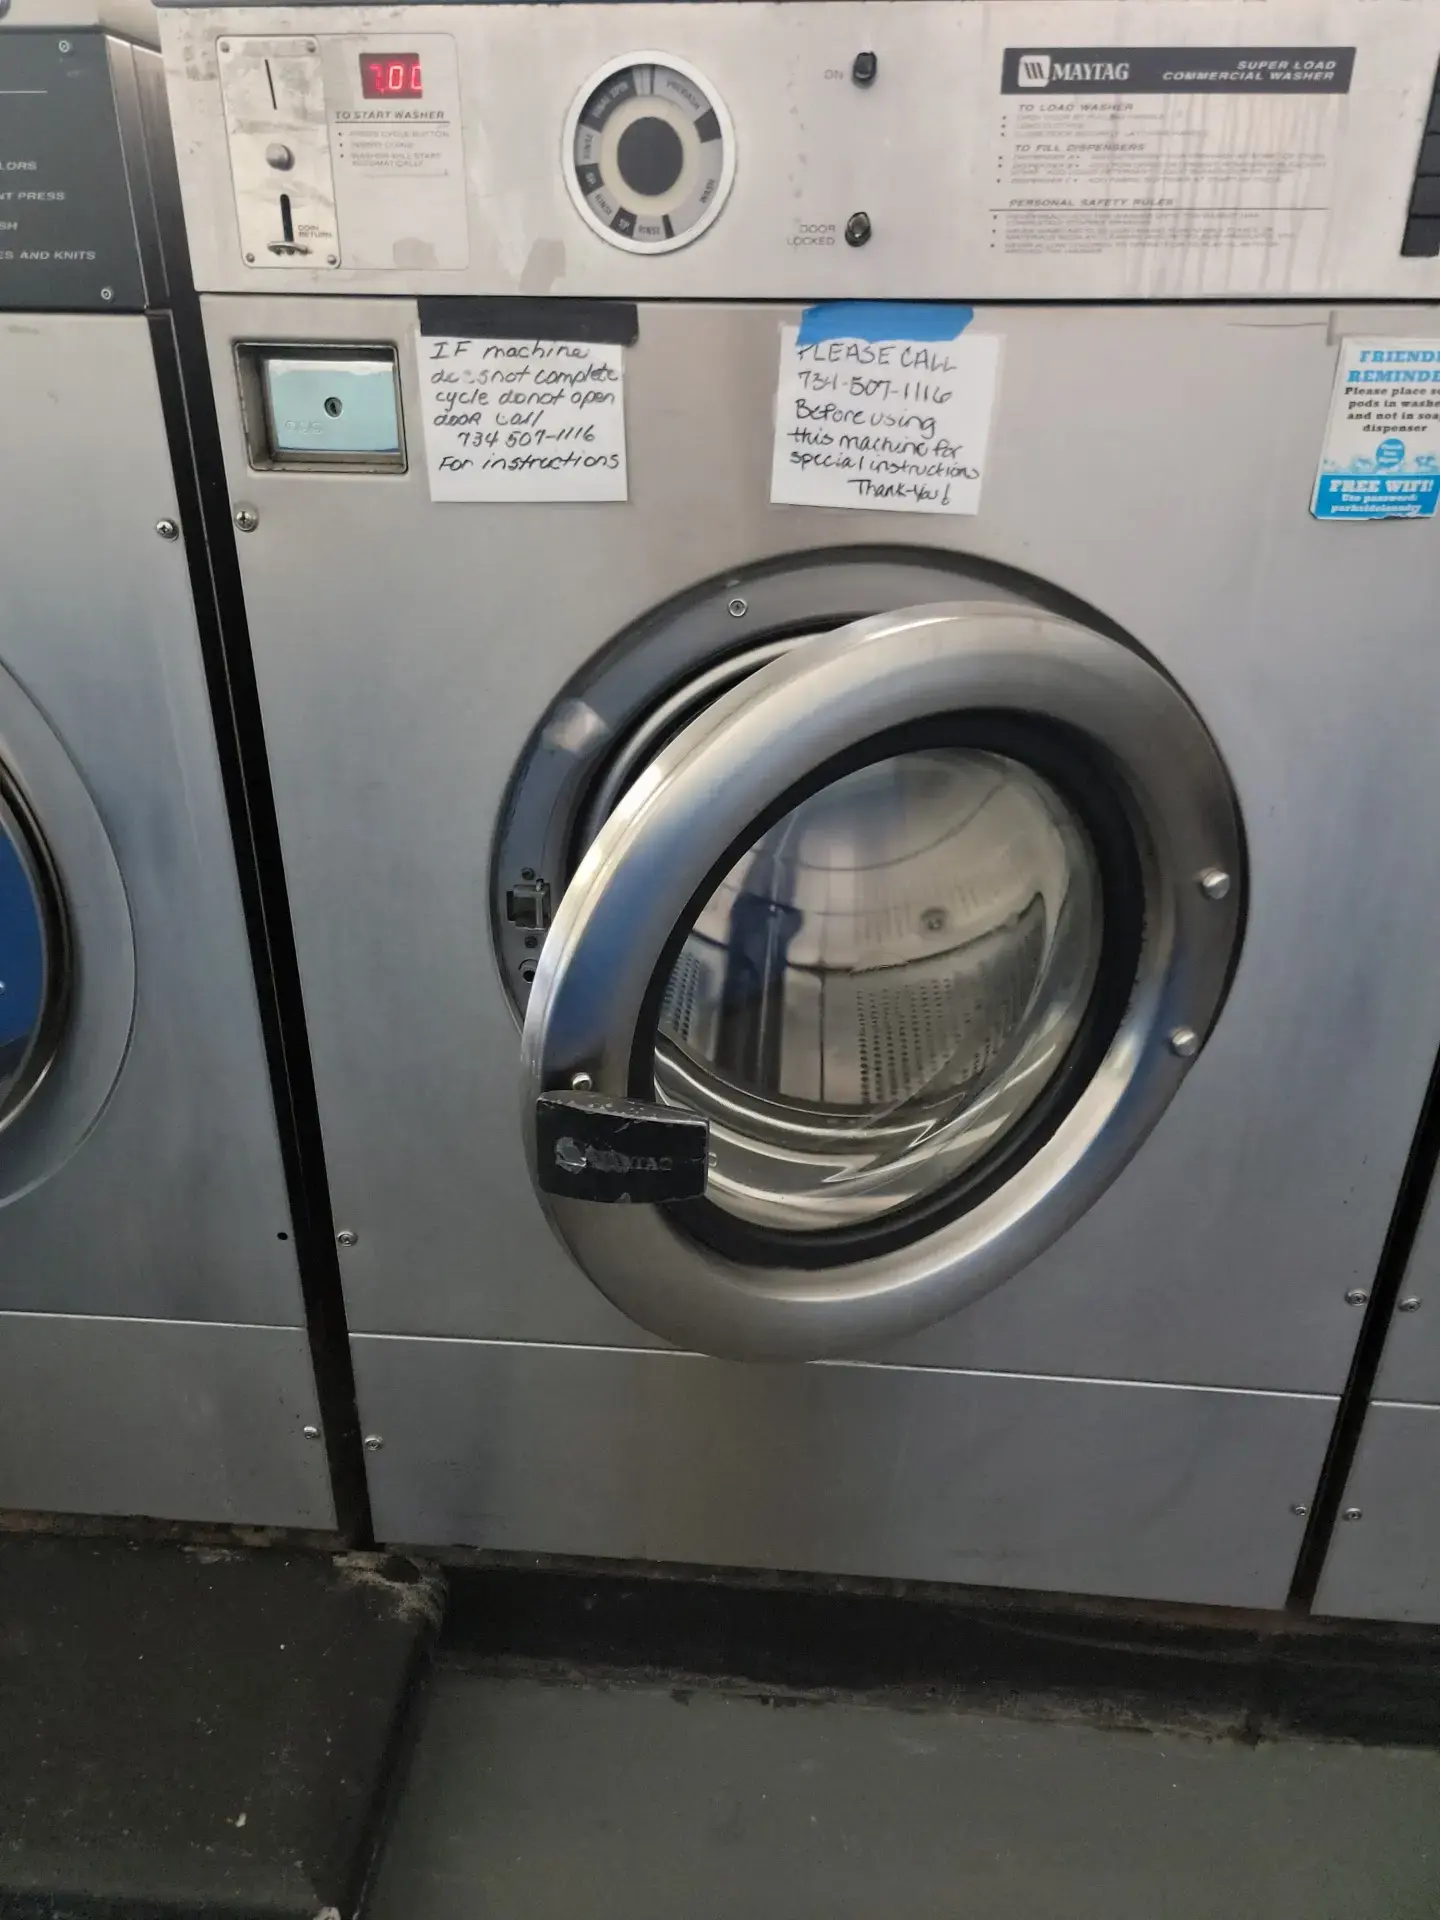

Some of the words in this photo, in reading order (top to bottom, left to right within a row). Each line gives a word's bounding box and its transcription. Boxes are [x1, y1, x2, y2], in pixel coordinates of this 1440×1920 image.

[1236, 60, 1290, 70] SUPER
[1293, 60, 1337, 70] LOAD
[824, 69, 844, 80] ON
[1052, 62, 1130, 80] MAYTAG
[1162, 71, 1264, 81] COMMERCIAL
[1269, 71, 1335, 81] WASHER
[1018, 104, 1035, 112] TO
[1040, 104, 1075, 112] LOAD
[1080, 103, 1134, 112] WASHER
[335, 110, 351, 119] TO
[353, 110, 391, 119] START
[394, 110, 445, 119] WASHER
[1015, 144, 1031, 152] TO
[1036, 144, 1061, 152] FILL
[1066, 143, 1146, 152] DISPENSERS
[18, 191, 65, 200] PRESS
[1009, 198, 1074, 207] PERSONAL
[1080, 198, 1128, 207] SAFETY
[1132, 198, 1173, 206] RULES
[800, 224, 836, 234] DOOR
[298, 231, 333, 239] RETURN
[787, 236, 836, 247] LOCKED
[20, 251, 50, 260] AND
[54, 250, 96, 260] KNITS
[483, 338, 590, 360] machine
[900, 346, 957, 372] CALL
[534, 362, 619, 388] complete
[799, 371, 953, 405] 734-507-1116
[1344, 387, 1388, 396] Please
[1391, 387, 1428, 398] place
[436, 388, 489, 411] cycle
[570, 390, 616, 410] open
[1348, 399, 1381, 410] pods
[1384, 399, 1397, 408] in
[1346, 412, 1373, 420] and
[1376, 412, 1398, 420] not
[1401, 412, 1415, 420] in
[1417, 412, 1440, 422] soa
[870, 409, 936, 439] using
[1362, 423, 1429, 435] dispenser
[458, 431, 498, 448] 734
[505, 425, 595, 448] 507-1116
[787, 427, 834, 446] this
[839, 434, 927, 457] machine
[932, 438, 963, 460] for
[438, 455, 475, 472] For
[482, 451, 620, 471] instructions
[789, 451, 865, 472] special
[869, 454, 980, 480] instructions
[1328, 479, 1381, 493] FREE
